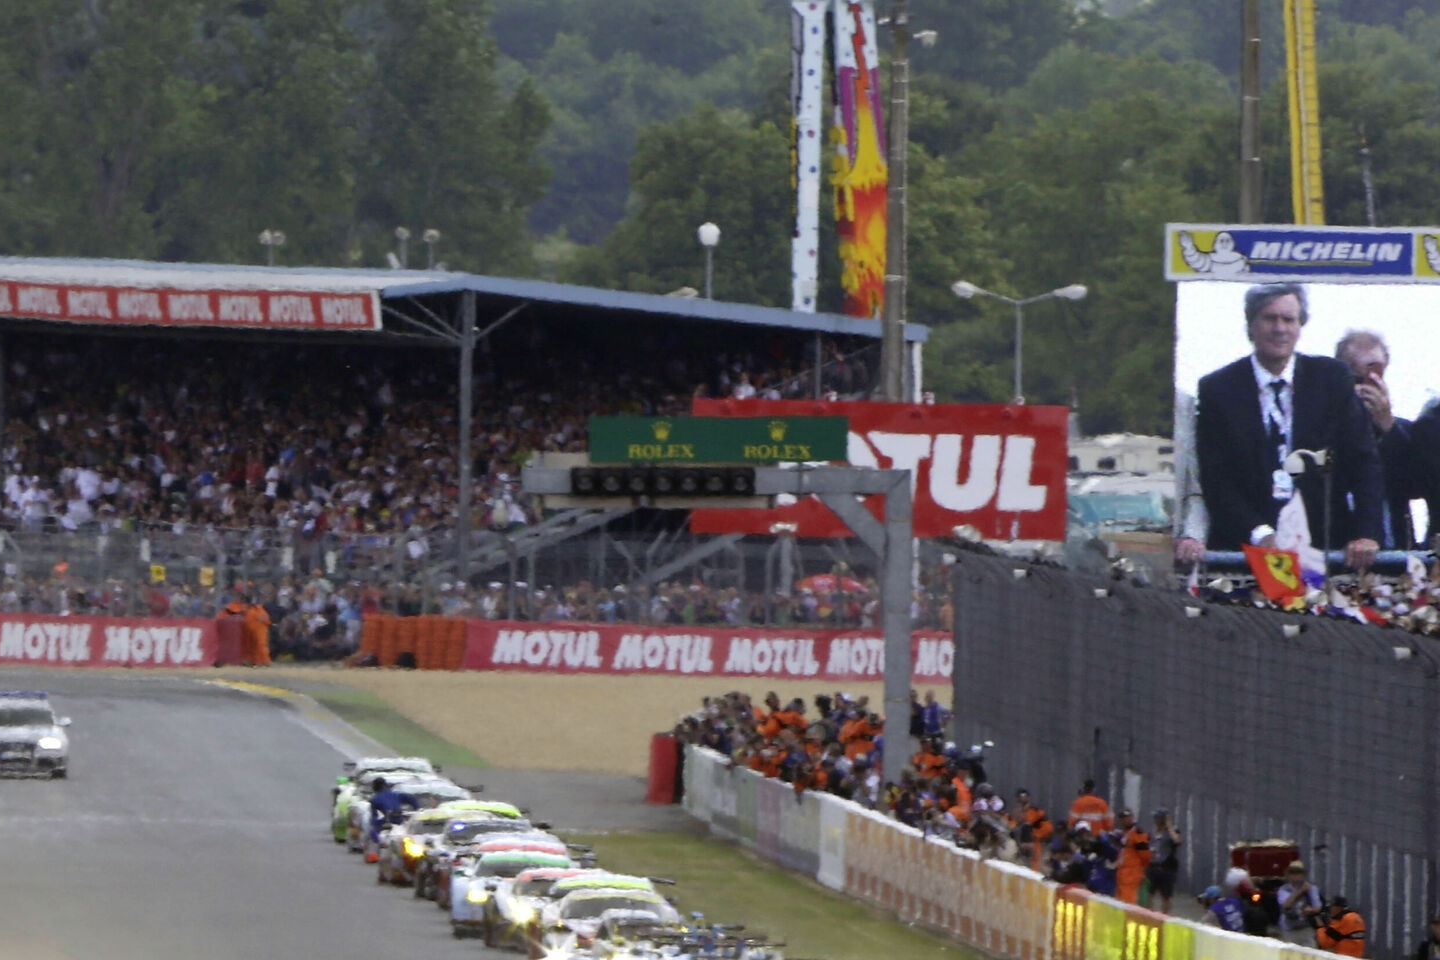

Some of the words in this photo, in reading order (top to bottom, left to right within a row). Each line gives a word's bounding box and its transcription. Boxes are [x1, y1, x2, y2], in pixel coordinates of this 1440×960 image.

[1249, 241, 1403, 262] MICHELIN
[218, 295, 264, 322] MOTUL
[269, 295, 315, 323] MOTUL
[321, 297, 367, 324] MOTUL
[627, 443, 694, 460] ROLEX
[744, 444, 812, 460] ROLEX
[103, 625, 204, 664] MOTUL
[491, 629, 603, 669] MOTUL
[612, 633, 714, 673] MOTUL
[723, 636, 820, 676] MOTUL
